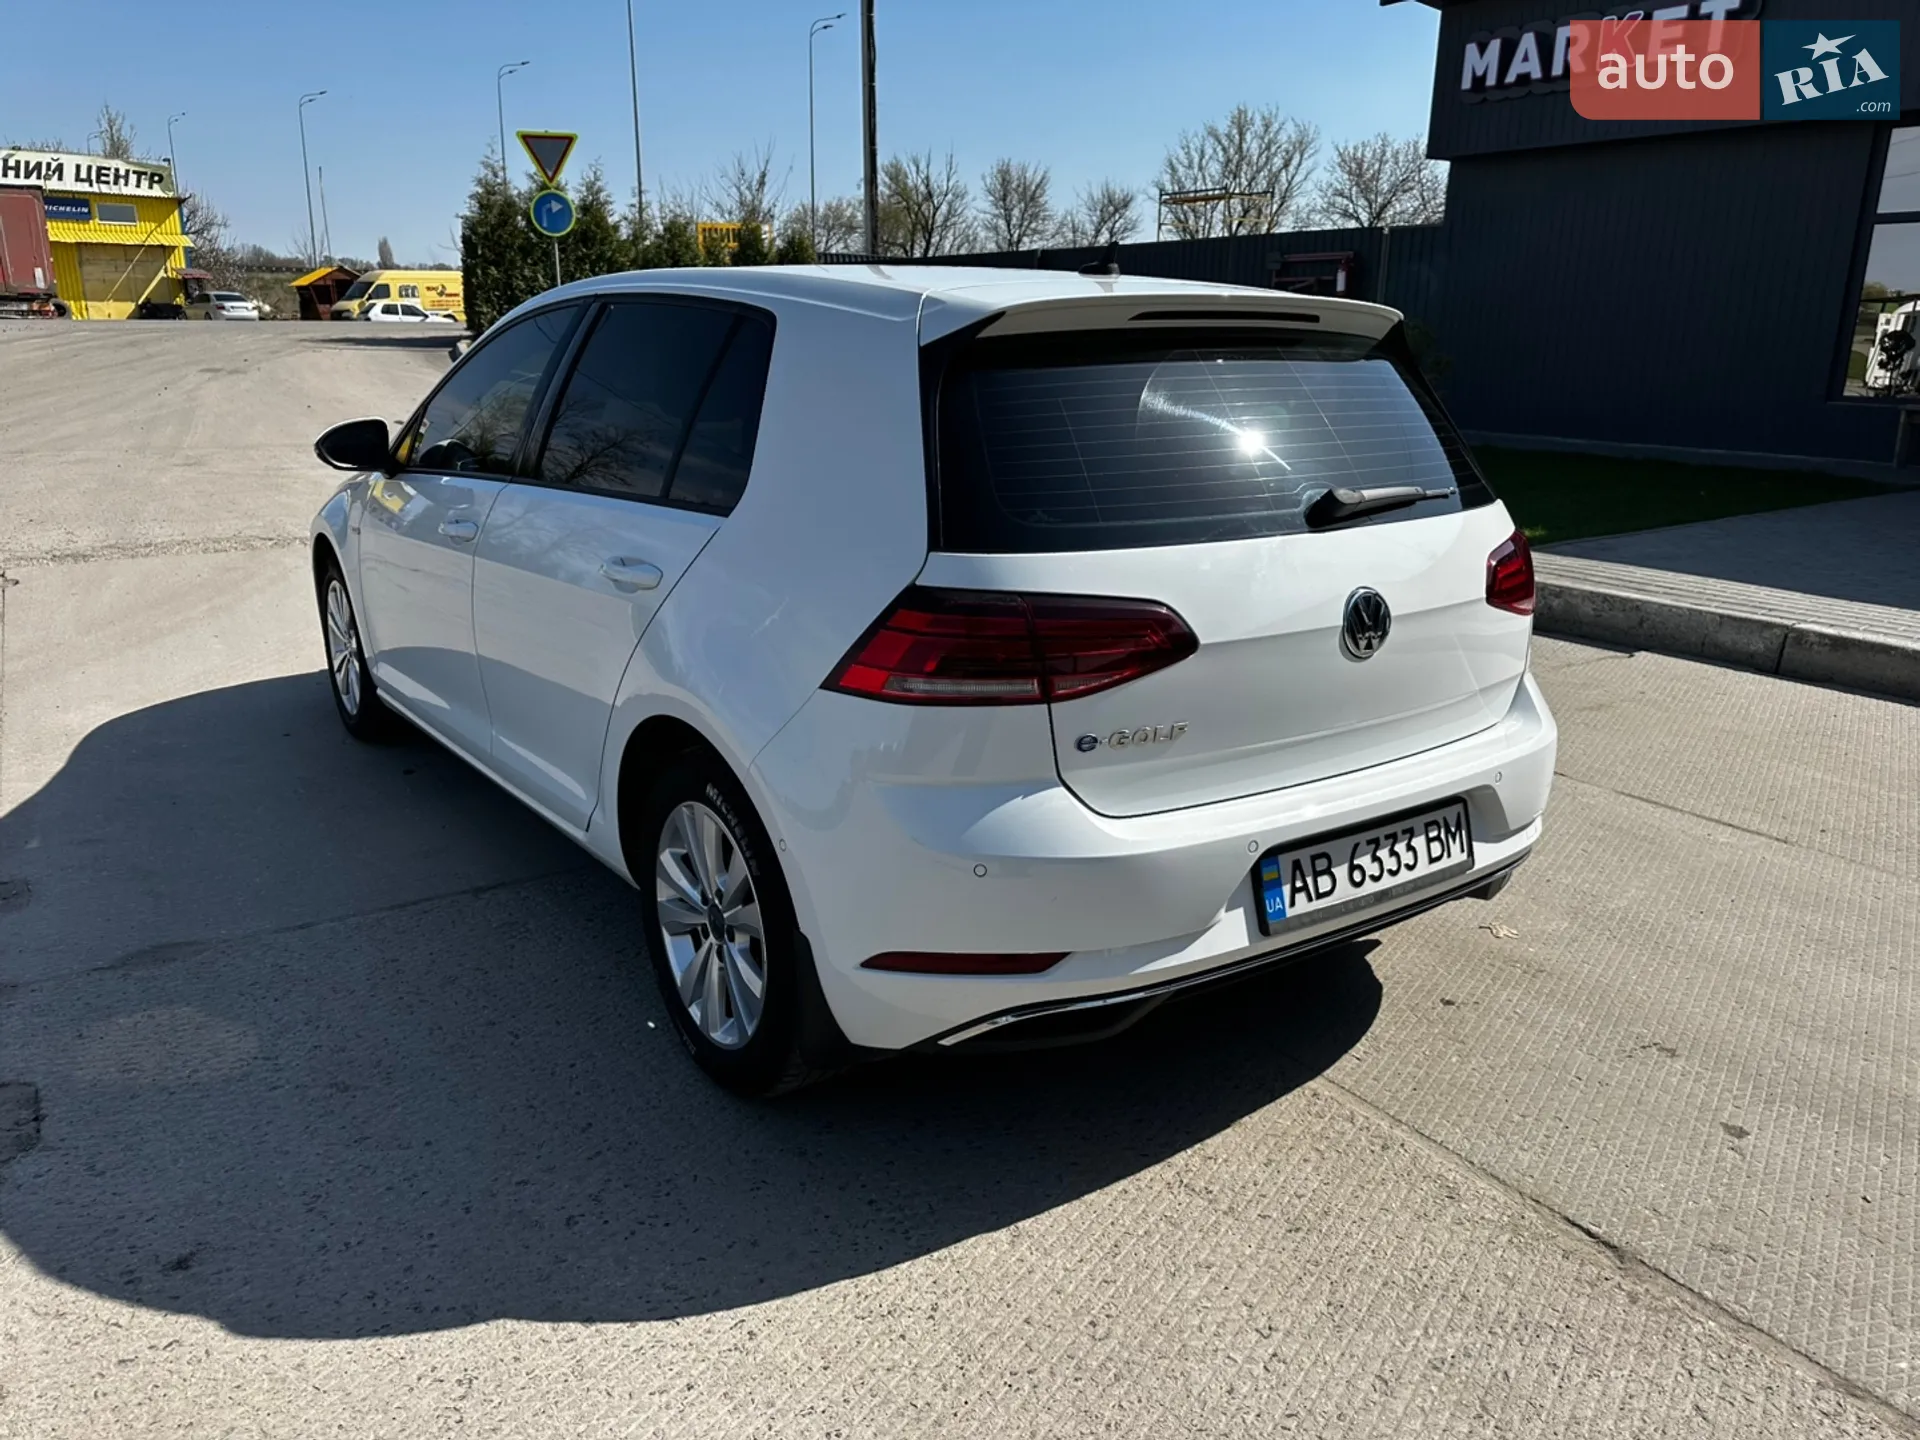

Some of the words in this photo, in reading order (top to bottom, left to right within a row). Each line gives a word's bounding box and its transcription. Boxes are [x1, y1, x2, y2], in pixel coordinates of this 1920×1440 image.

[1461, 0, 1743, 91] MARKET
[1, 157, 65, 182] НИЙ
[75, 163, 165, 190] ЦЕНТР
[1288, 851, 1338, 908] AB
[1347, 826, 1419, 888] 6333
[1423, 811, 1465, 866] BM
[1266, 895, 1284, 913] UA
